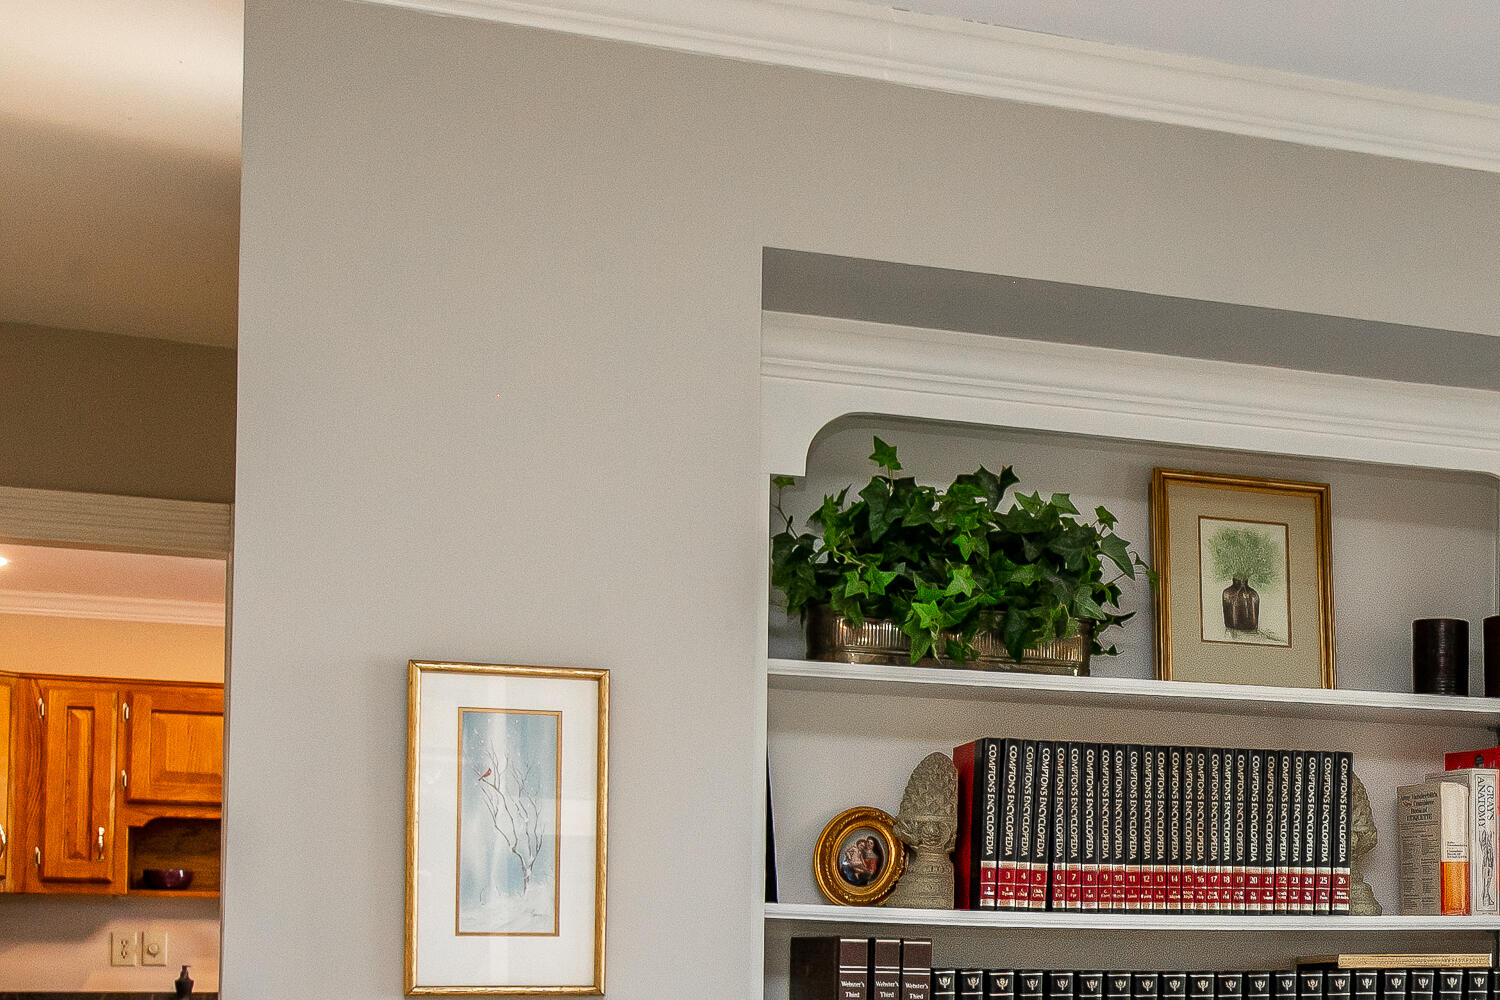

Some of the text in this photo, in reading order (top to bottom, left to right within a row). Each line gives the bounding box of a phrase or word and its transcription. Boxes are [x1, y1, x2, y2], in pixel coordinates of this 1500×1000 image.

[986, 794, 995, 855] ENCYCLOPEDIA
[1036, 797, 1048, 858] ENCYCLOPEDIA
[1070, 797, 1079, 858] ENCYCLOPEDIA
[1477, 776, 1486, 829] ANATOMY
[1305, 804, 1314, 862] ENCYCLOPEDIA
[1305, 876, 1312, 884] 24
[1320, 876, 1328, 884] 25
[1338, 876, 1346, 884] 26
